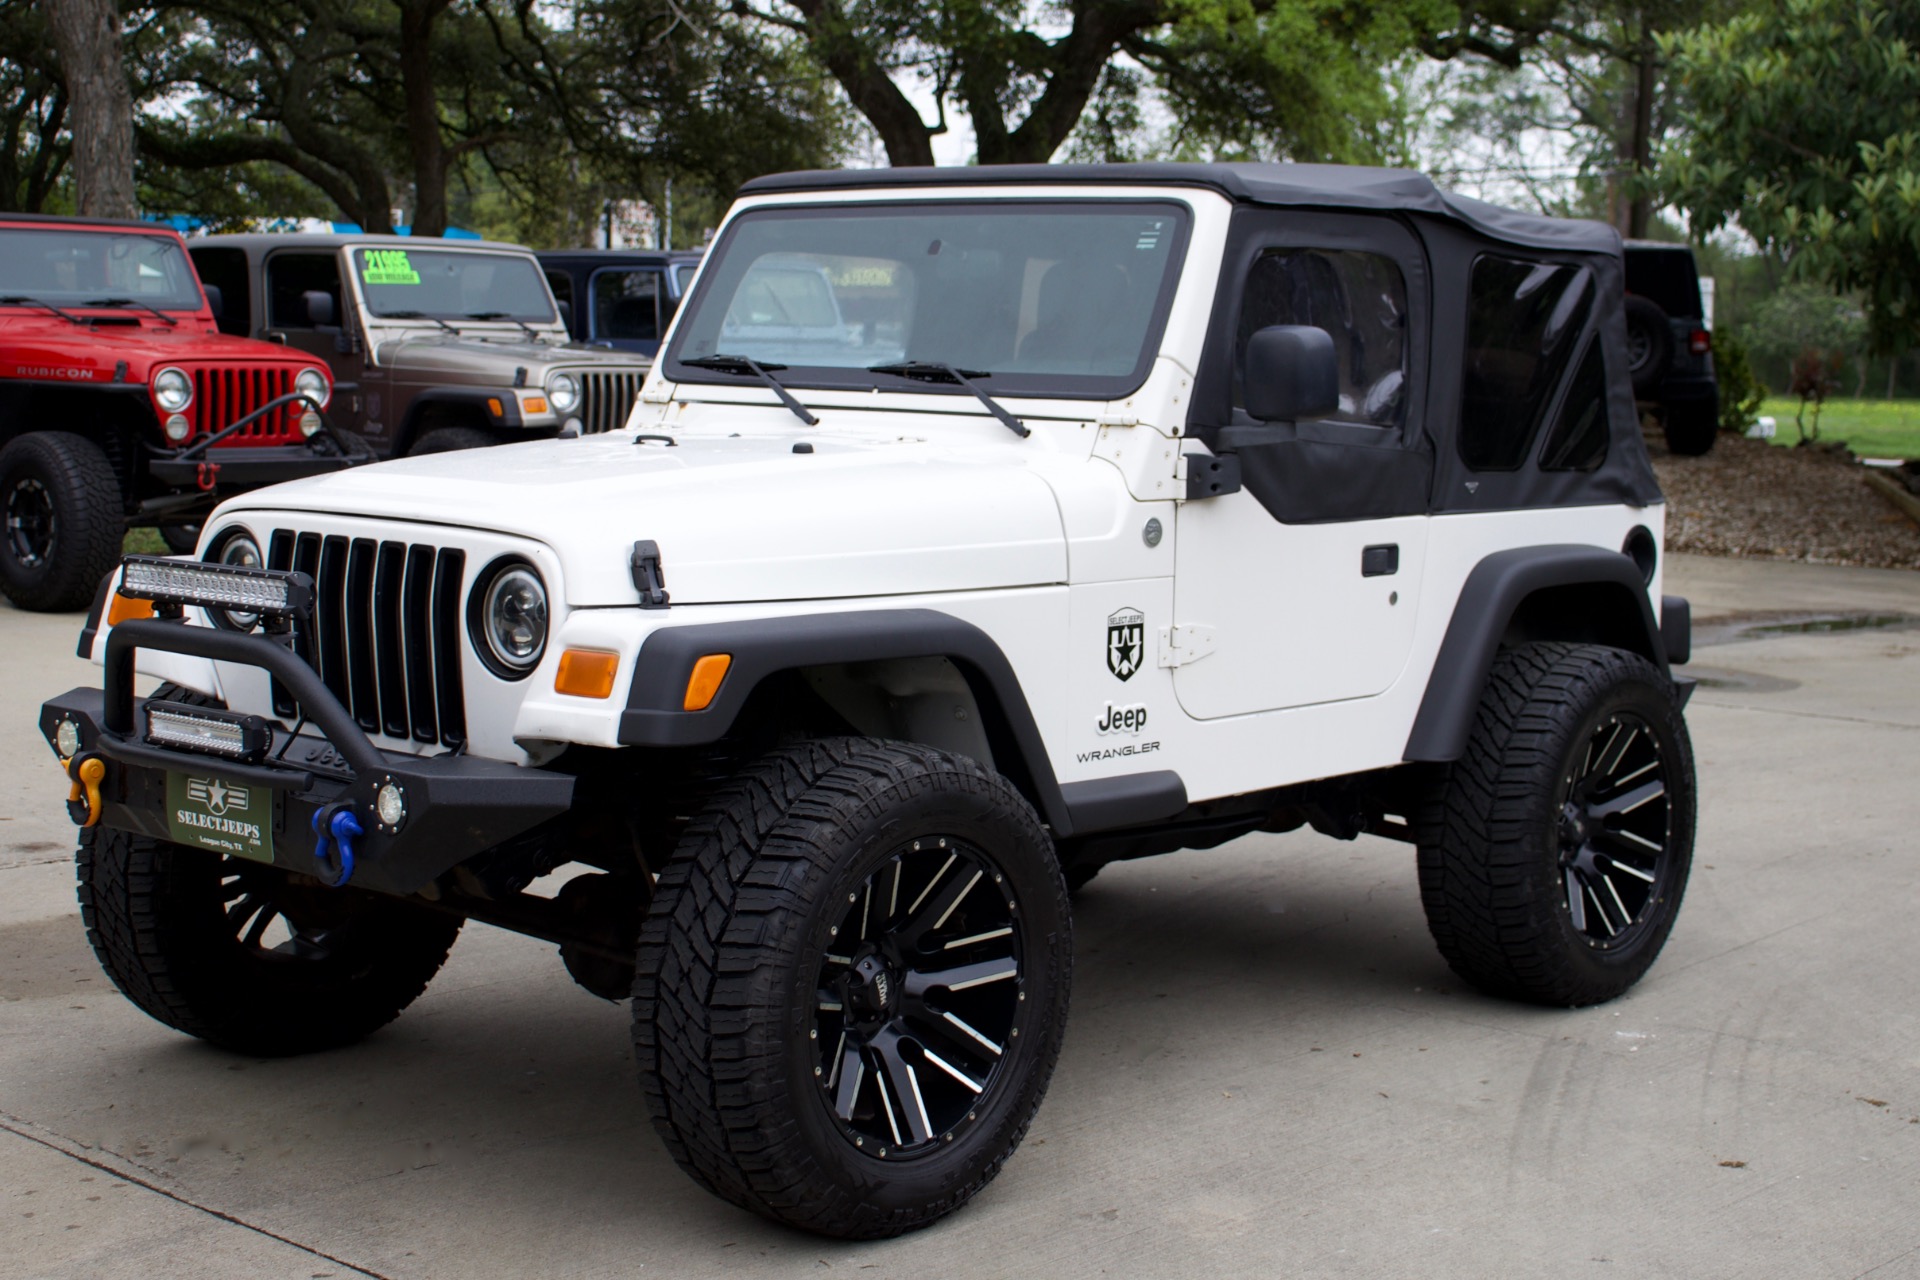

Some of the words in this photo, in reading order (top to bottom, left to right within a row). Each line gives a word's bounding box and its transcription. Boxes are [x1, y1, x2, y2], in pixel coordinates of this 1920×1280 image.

[363, 250, 412, 271] 21995
[17, 366, 93, 379] RUBICON
[1109, 616, 1128, 625] SELECT
[1128, 614, 1144, 623] JEEPS
[1098, 705, 1147, 732] Jeep
[1077, 741, 1161, 763] WRANGLER
[177, 809, 260, 839] SELECTJEEPS
[199, 835, 220, 846] League
[234, 842, 243, 851] TX
